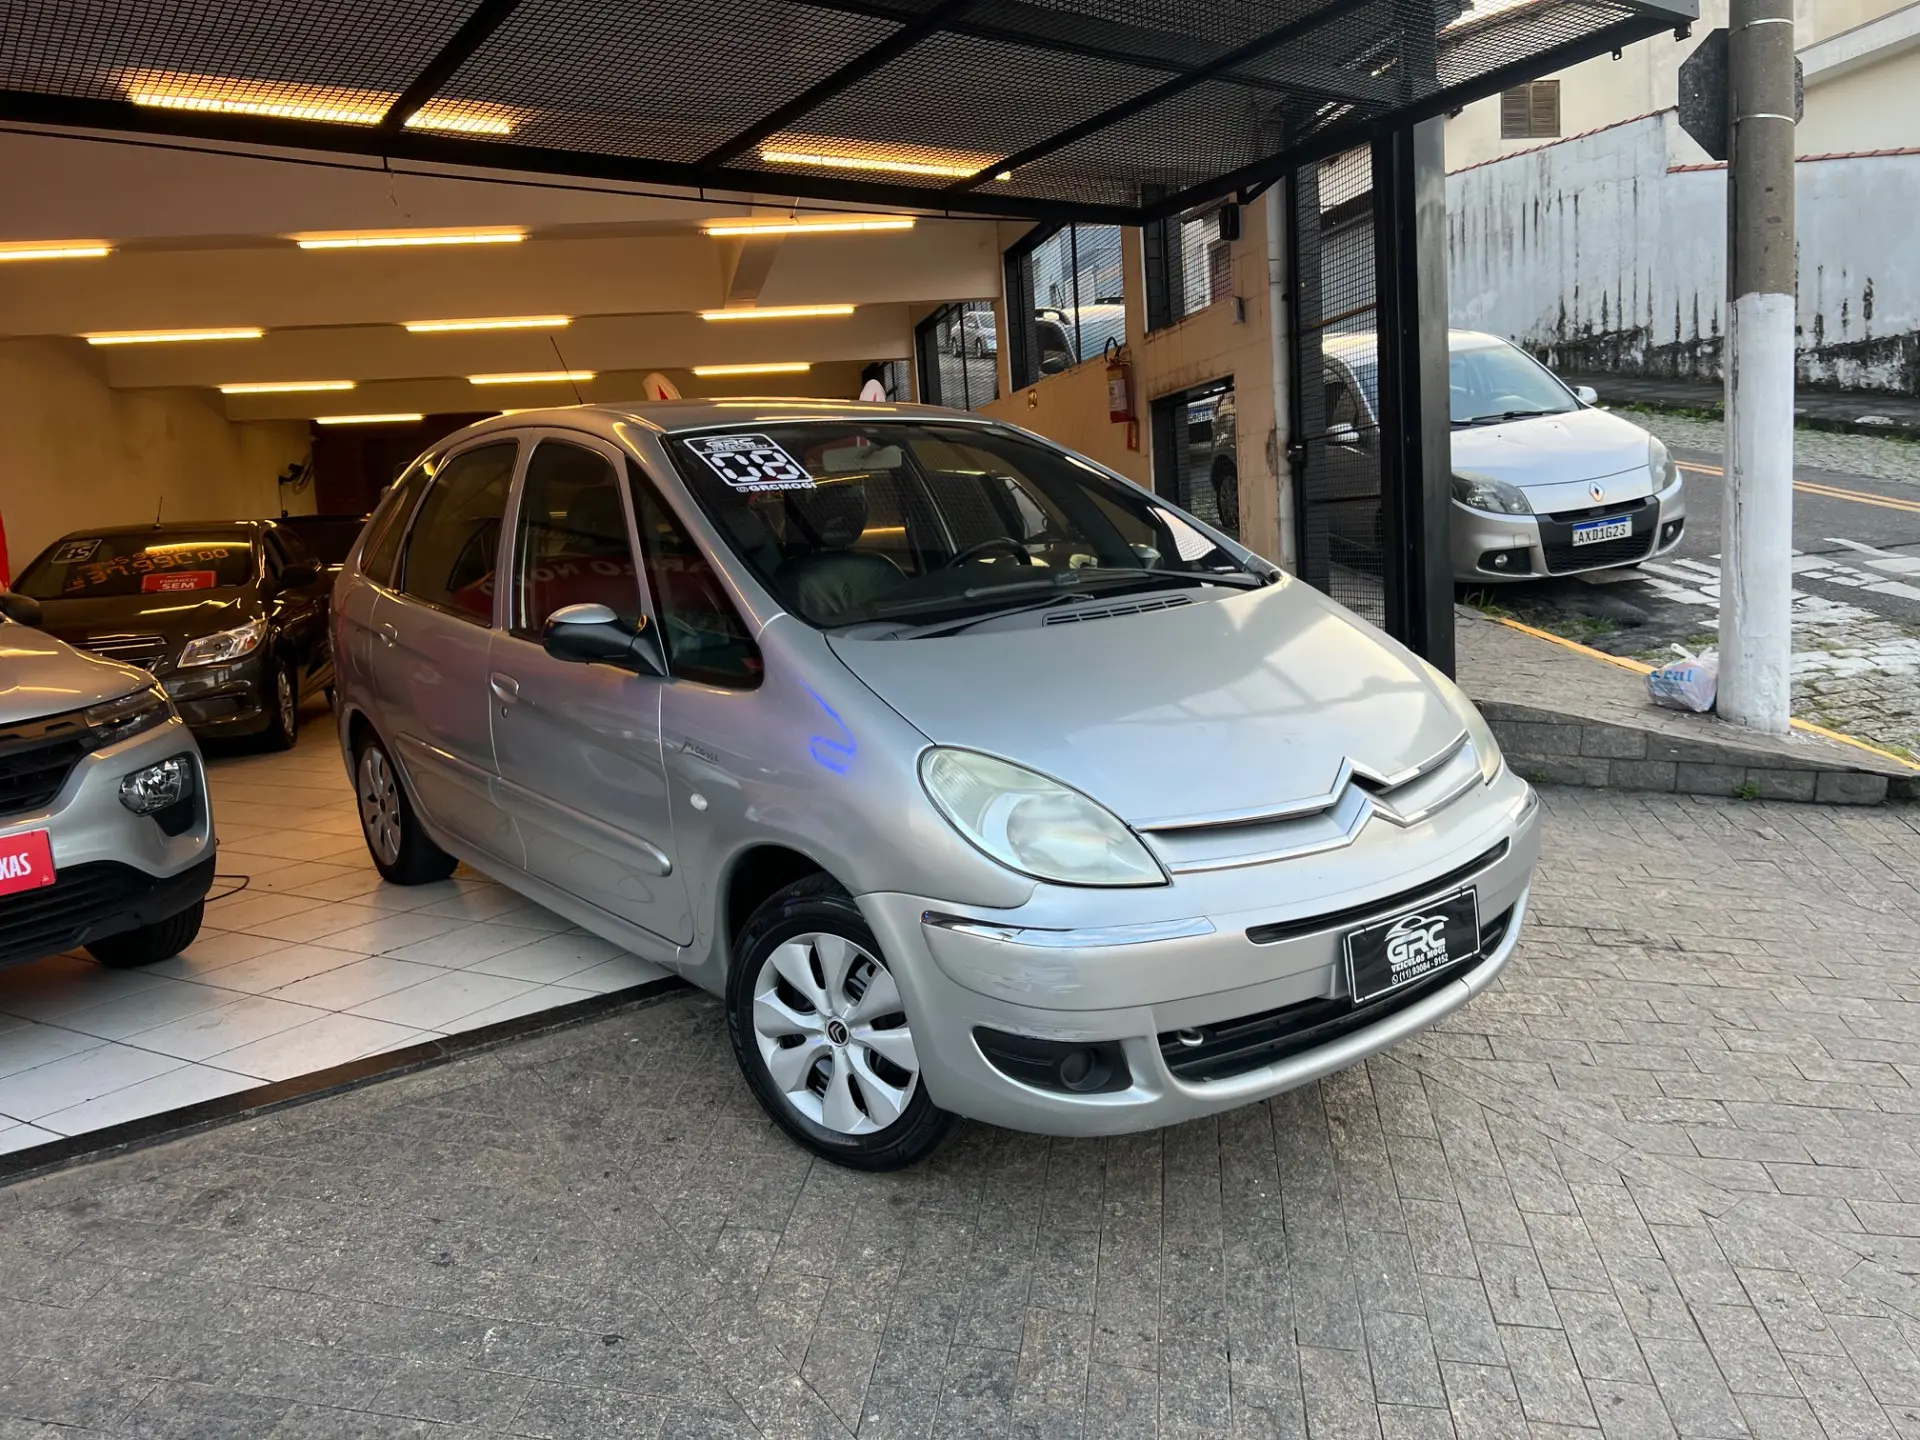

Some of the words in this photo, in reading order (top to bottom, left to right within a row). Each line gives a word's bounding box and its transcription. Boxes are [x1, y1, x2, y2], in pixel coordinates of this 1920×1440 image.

[710, 449, 801, 483] 08
[1578, 525, 1626, 543] AXD1G23
[67, 547, 90, 559] 15
[162, 582, 195, 590] SEM
[1387, 921, 1446, 963] GRC
[1391, 954, 1425, 973] VEICULOS
[1426, 945, 1446, 959] MOGI
[1399, 968, 1412, 982] (11)
